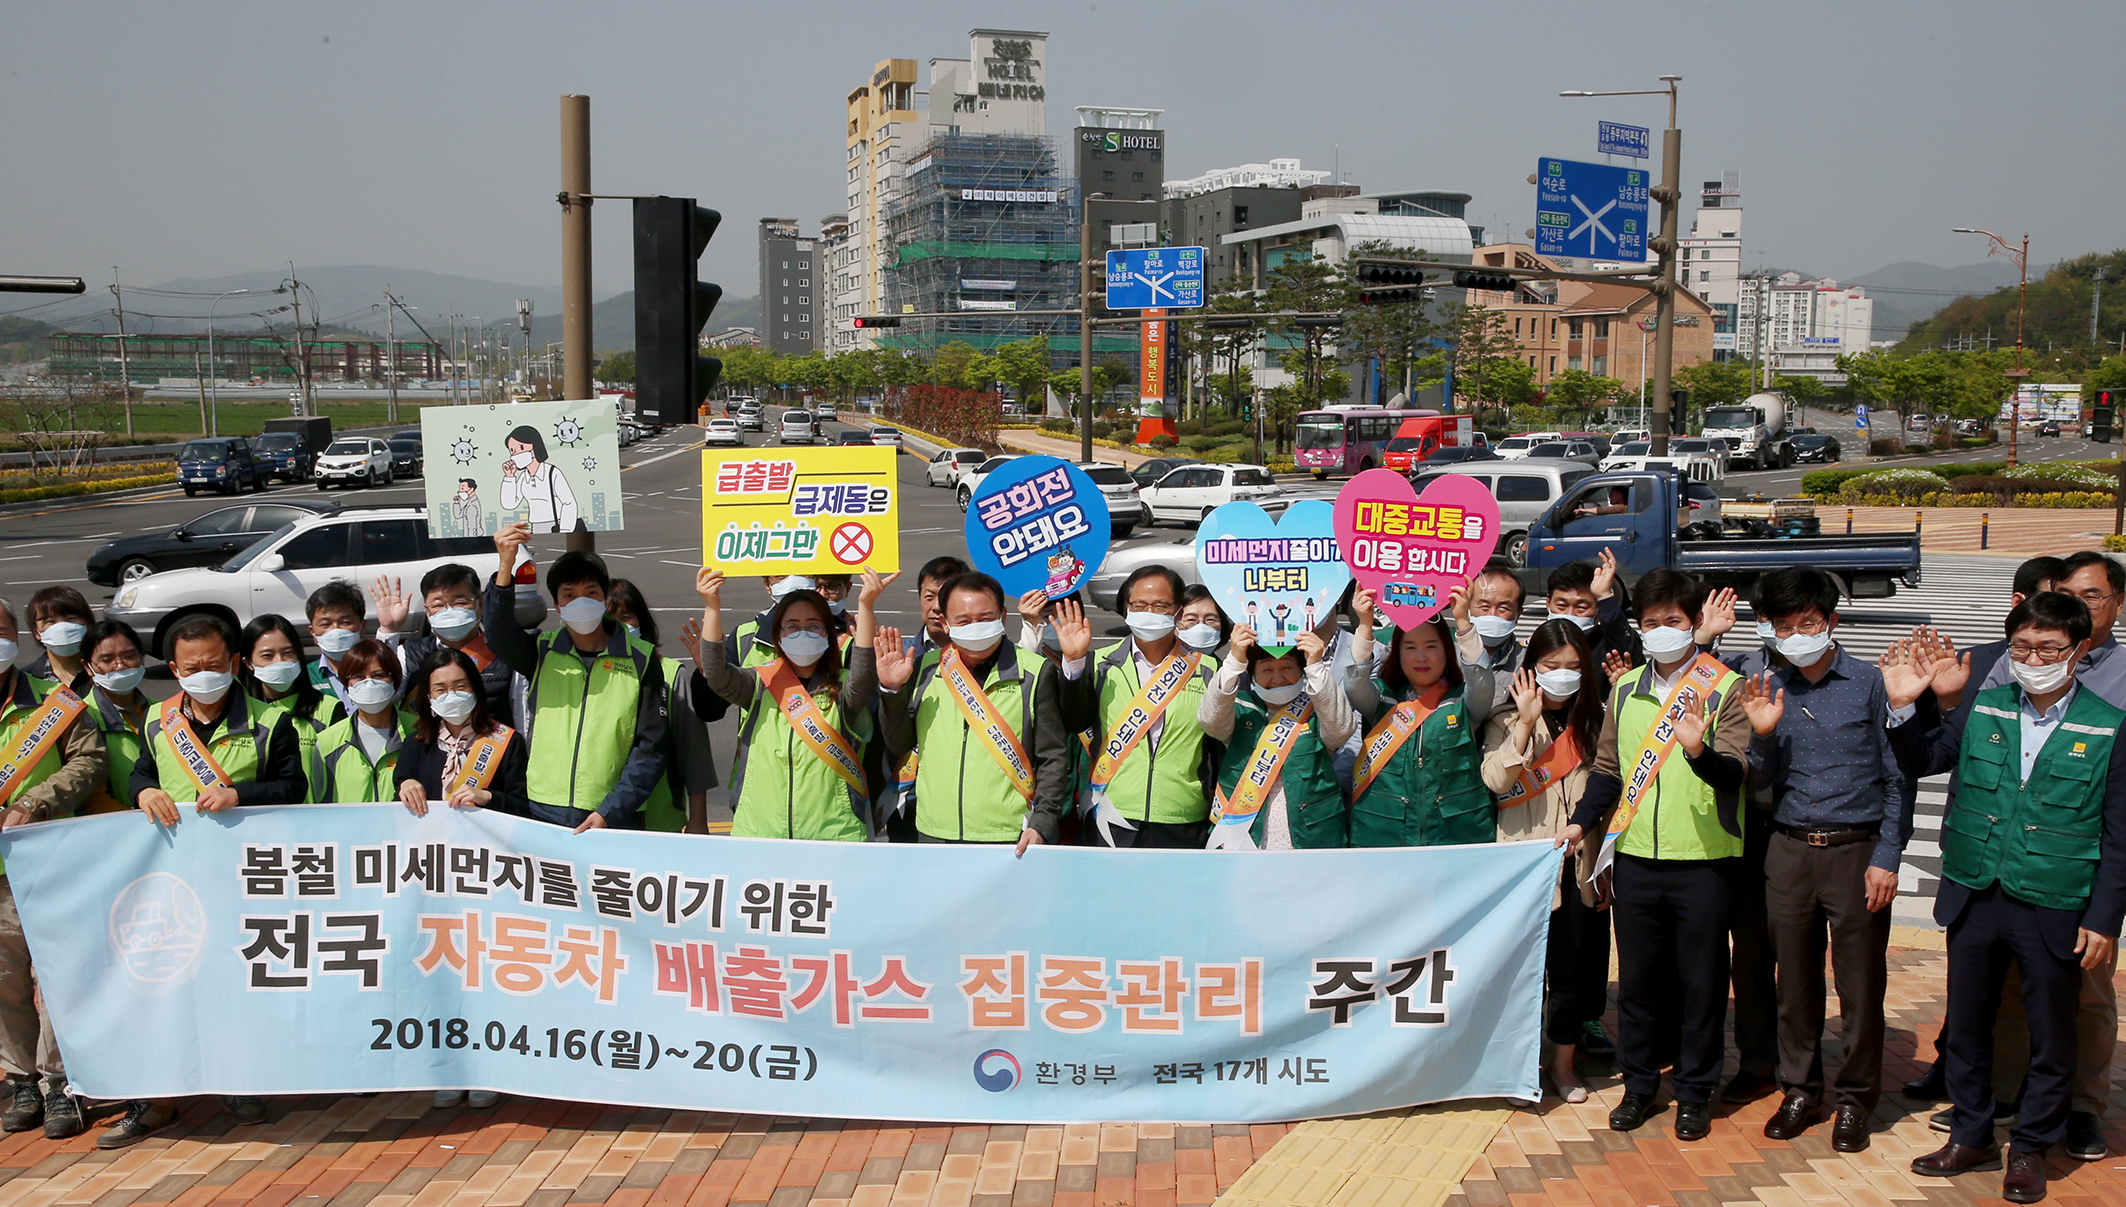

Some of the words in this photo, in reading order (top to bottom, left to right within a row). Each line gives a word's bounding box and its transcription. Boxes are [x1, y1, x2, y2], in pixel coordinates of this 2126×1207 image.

[1122, 136, 1160, 149] HOTEL
[1543, 177, 1566, 192] 여순로
[1618, 186, 1648, 202] 남승룡로
[1540, 242, 1562, 253] Gasan-ro
[1541, 228, 1564, 242] 가산로
[1619, 234, 1640, 248] 팔마로
[1144, 260, 1163, 269] 팔마로
[1178, 260, 1198, 269] 백강로
[1618, 247, 1639, 258] Palma-ro
[1108, 272, 1134, 281] 남승룡로
[1178, 290, 1197, 298] 가산로
[1147, 346, 1159, 396] 행복도시
[718, 462, 794, 493] 급출발
[795, 484, 888, 515] 급제동은
[979, 467, 1073, 529] 공회전
[993, 506, 1088, 566] 안돼요
[1355, 501, 1483, 540] 대중교통을
[716, 527, 818, 560] 이제그만
[1353, 539, 1403, 570] 이용
[1407, 547, 1466, 575] 합시다
[1245, 568, 1307, 591] 나부터
[1146, 655, 1188, 706] 공회전
[1106, 706, 1149, 760] 안돼요
[172, 728, 218, 787] 대중교통을
[1249, 749, 1279, 787] 나부터
[1626, 748, 1660, 806] 안돼요
[242, 845, 334, 897] 봄철
[355, 845, 580, 907] 미세먼지를
[591, 868, 725, 931] 줄이기
[740, 884, 832, 935] 위한
[242, 914, 386, 988] 전국
[418, 914, 626, 1003] 자동차
[653, 939, 931, 1029] 배출가스
[962, 954, 1262, 1035] 집중관리
[1308, 949, 1454, 1026] 주간
[371, 1017, 818, 1081] 2018.04.16(월)~20(금)
[1035, 1060, 1118, 1086] 환경부
[1153, 1061, 1206, 1085] 전국
[1213, 1057, 1268, 1086] 17개
[1277, 1057, 1330, 1086] 시도
